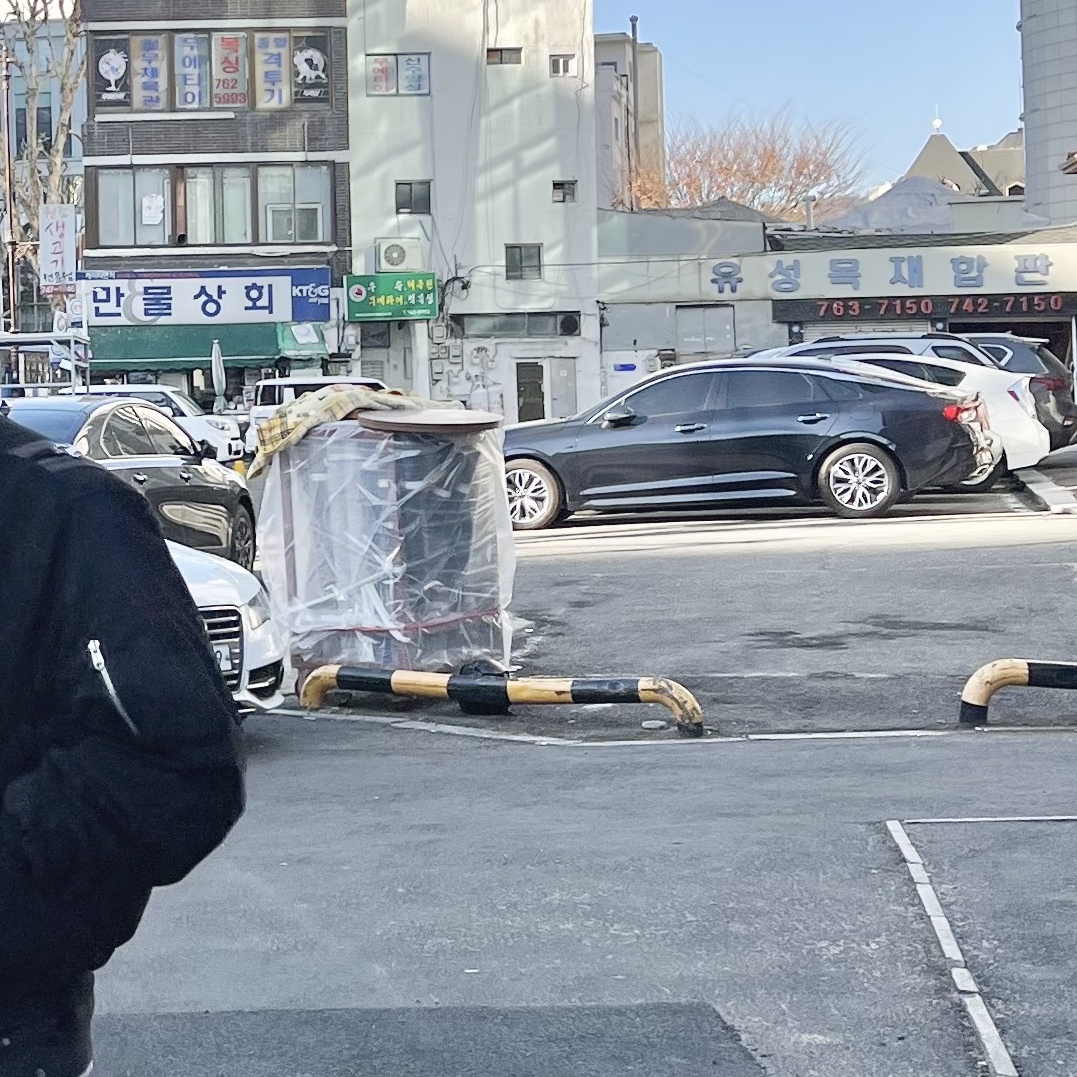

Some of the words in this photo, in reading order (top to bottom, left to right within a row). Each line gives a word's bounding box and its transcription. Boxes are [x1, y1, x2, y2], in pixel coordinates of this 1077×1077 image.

[220, 36, 240, 74] 복싱
[263, 51, 284, 106] 격투기
[44, 221, 66, 269] 생고기
[291, 283, 330, 298] KT&G
[710, 253, 1054, 293] 유성목재합판
[92, 282, 275, 319] 만물상회
[816, 298, 934, 318] 763-7150
[947, 294, 1064, 315] 742-7150
